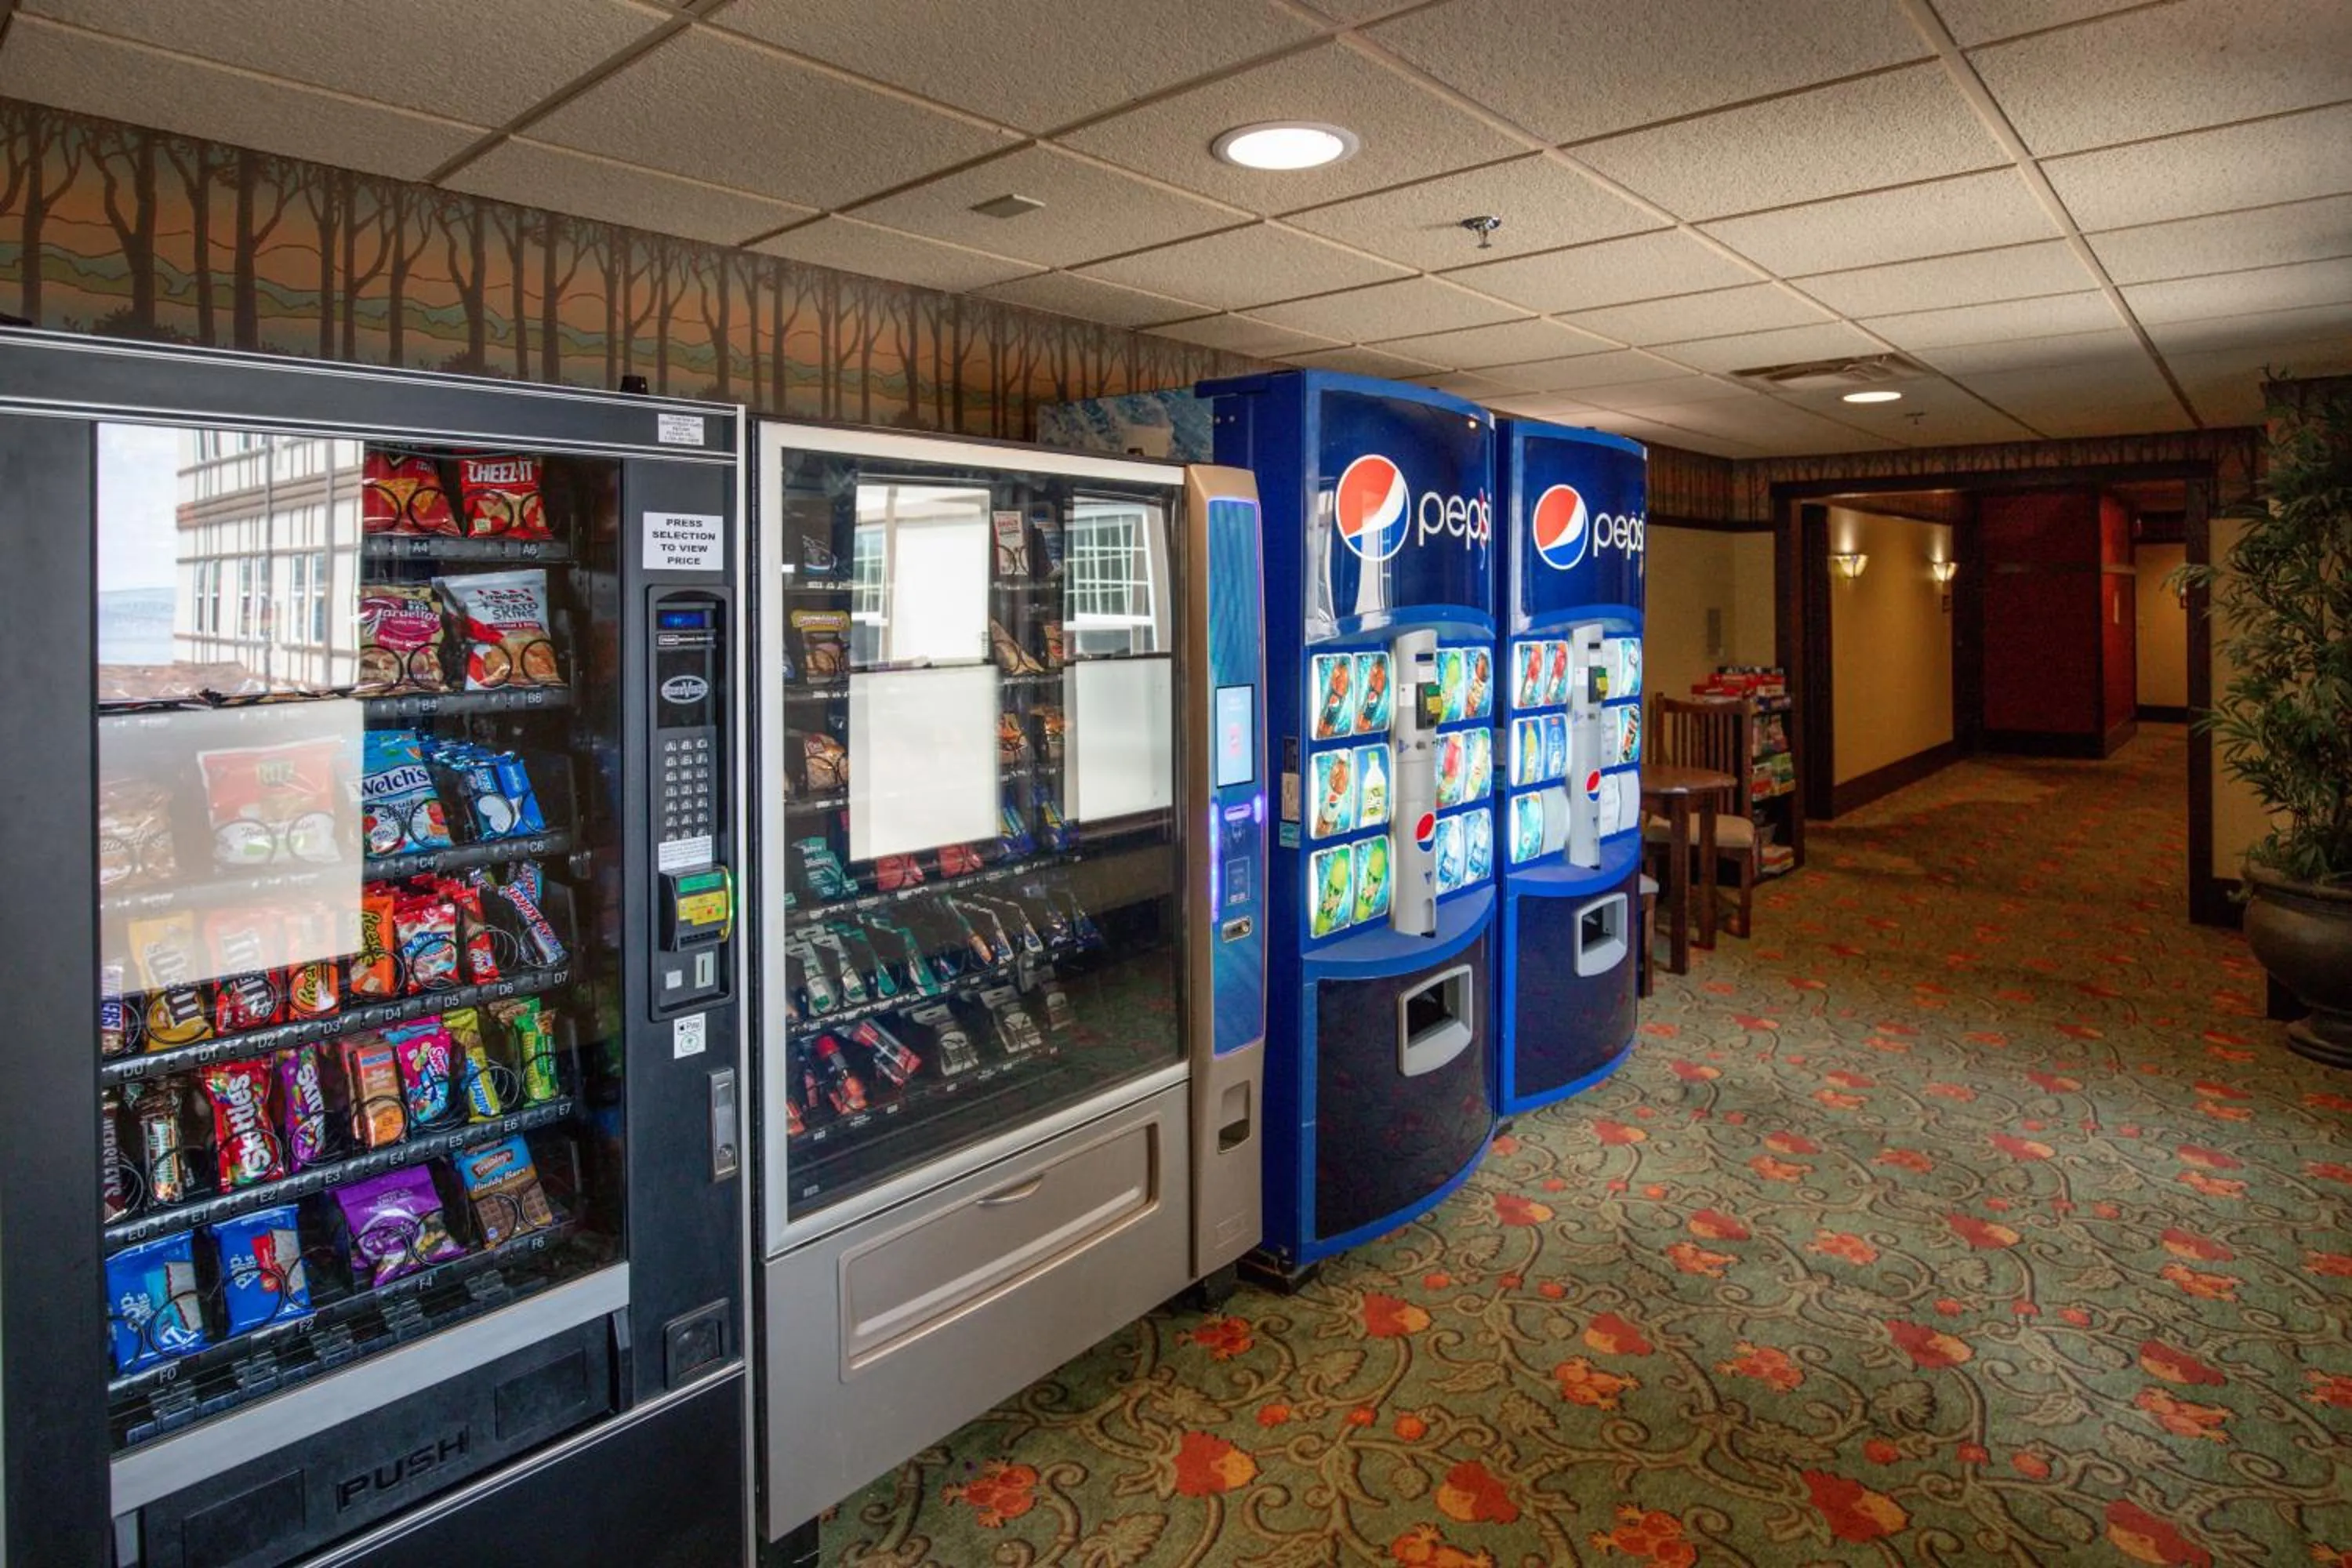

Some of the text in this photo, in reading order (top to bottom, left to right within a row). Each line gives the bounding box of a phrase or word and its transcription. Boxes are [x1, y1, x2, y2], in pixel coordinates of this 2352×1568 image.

[666, 518, 702, 528] PRESS
[1418, 492, 1491, 550] pepsi
[652, 531, 716, 540] SELECTION
[1593, 511, 1644, 560] pepsi
[667, 556, 701, 565] PRICE
[554, 971, 569, 984] D7
[445, 996, 459, 1007] D5
[385, 1008, 401, 1020] D4
[324, 1022, 340, 1034] D3
[258, 1036, 276, 1048] D2
[559, 1104, 572, 1116] E7
[227, 1074, 272, 1176] Skittles
[504, 1120, 518, 1131] E6
[449, 1135, 463, 1148] E5
[390, 1152, 405, 1164] E4
[325, 1171, 340, 1183] E3
[260, 1190, 277, 1202] E2
[338, 1427, 469, 1511] PUSH
